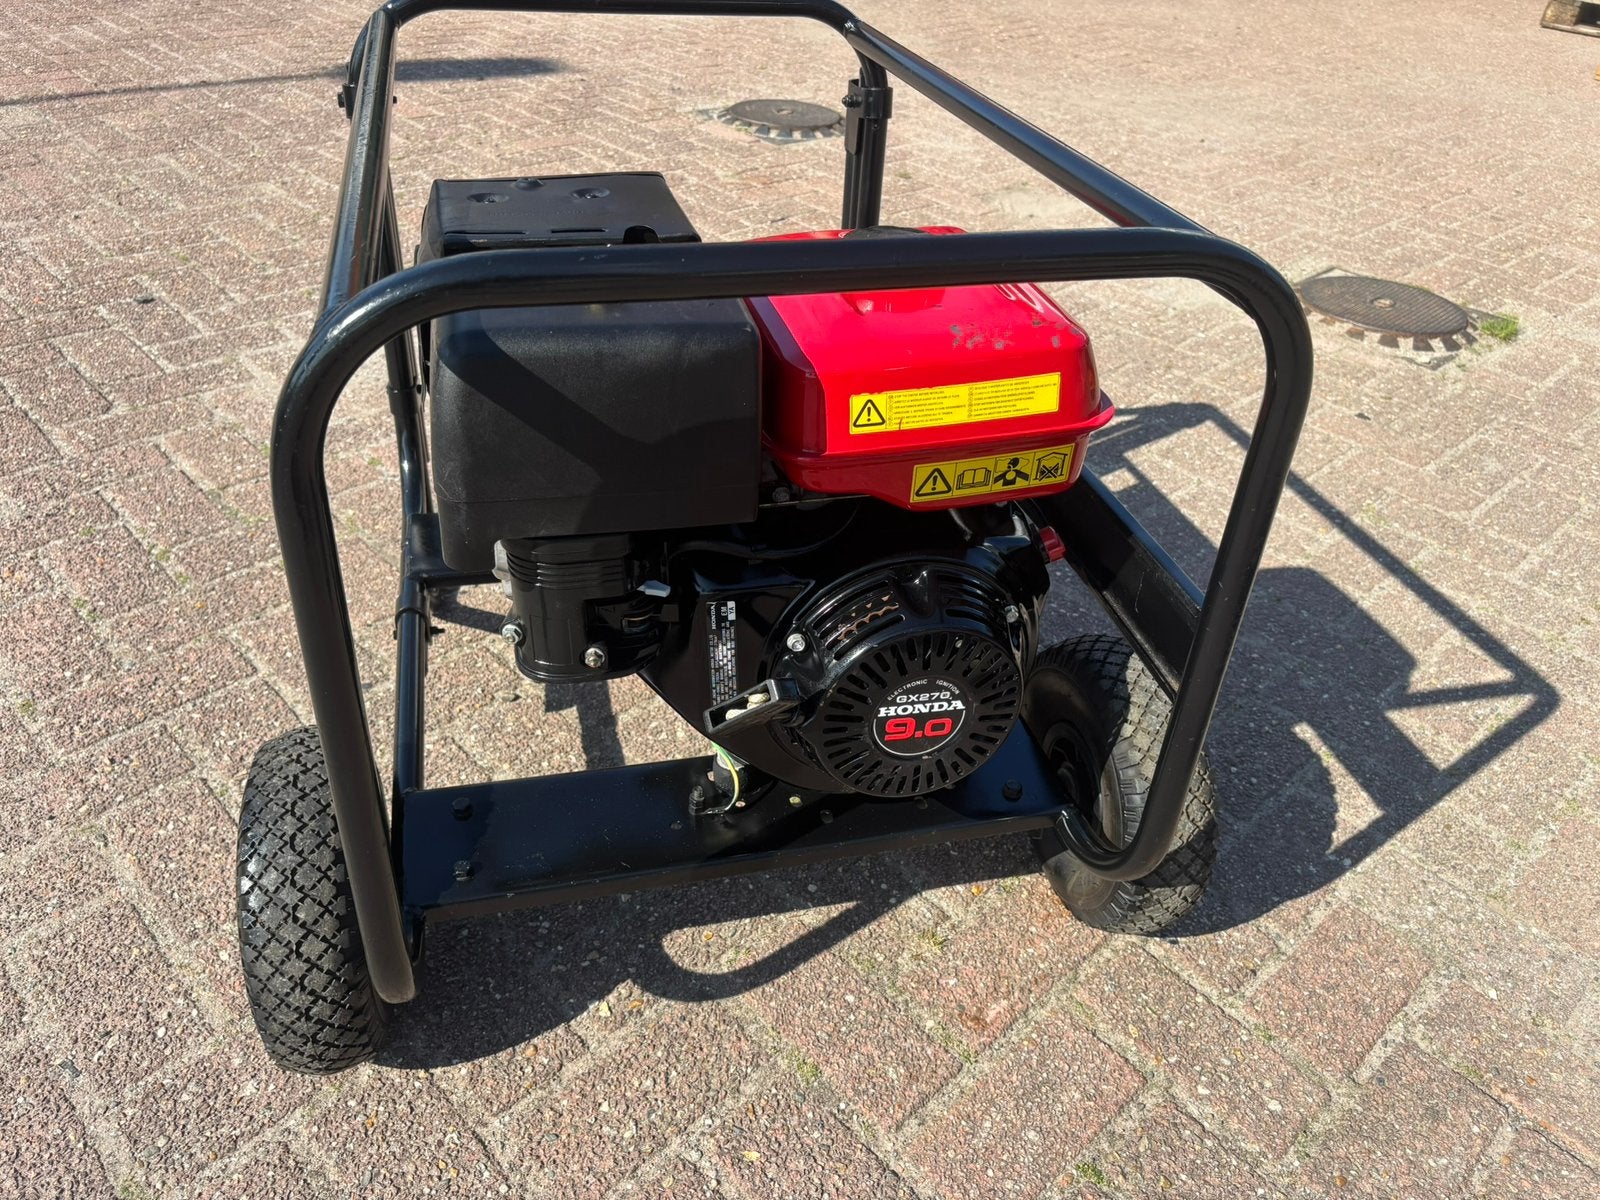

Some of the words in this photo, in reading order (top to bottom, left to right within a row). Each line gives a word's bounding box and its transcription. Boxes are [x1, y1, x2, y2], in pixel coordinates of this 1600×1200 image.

[887, 679, 928, 701] ELECTRONIC
[936, 680, 961, 695] IGNITION
[896, 691, 951, 703] GX270
[877, 700, 966, 717] HONDA
[884, 717, 953, 741] 9.0
